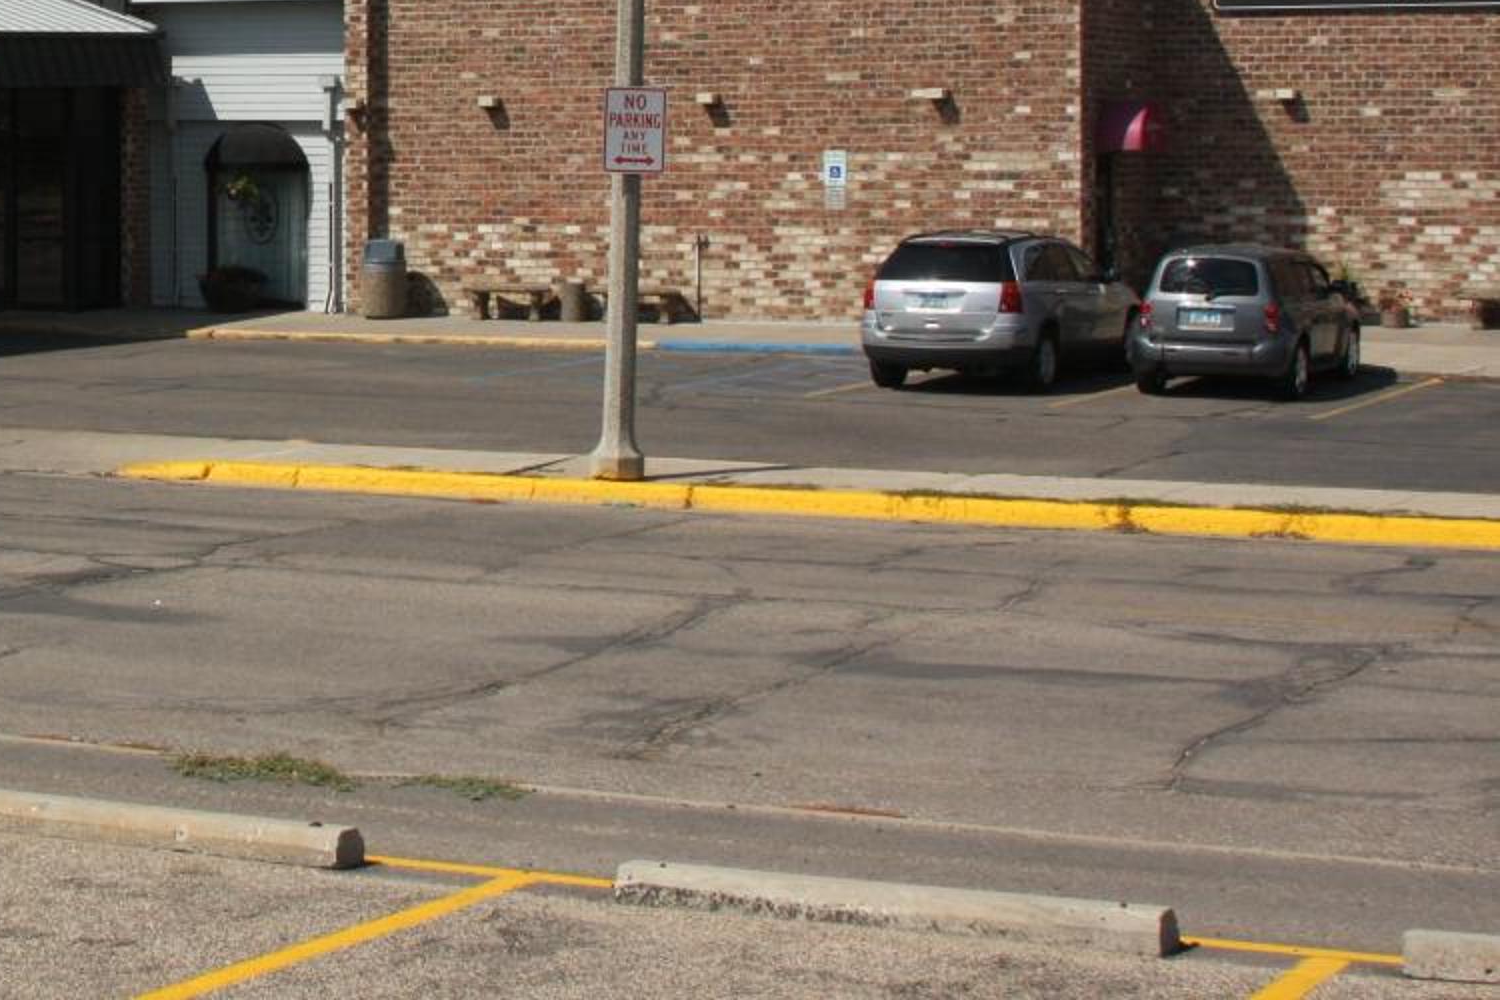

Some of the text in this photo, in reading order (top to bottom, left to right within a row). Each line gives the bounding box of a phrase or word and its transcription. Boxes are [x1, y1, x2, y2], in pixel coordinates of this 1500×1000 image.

[624, 94, 647, 110] NO
[609, 112, 661, 129] PARKING
[623, 131, 645, 141] ANY
[621, 143, 648, 154] TIME
